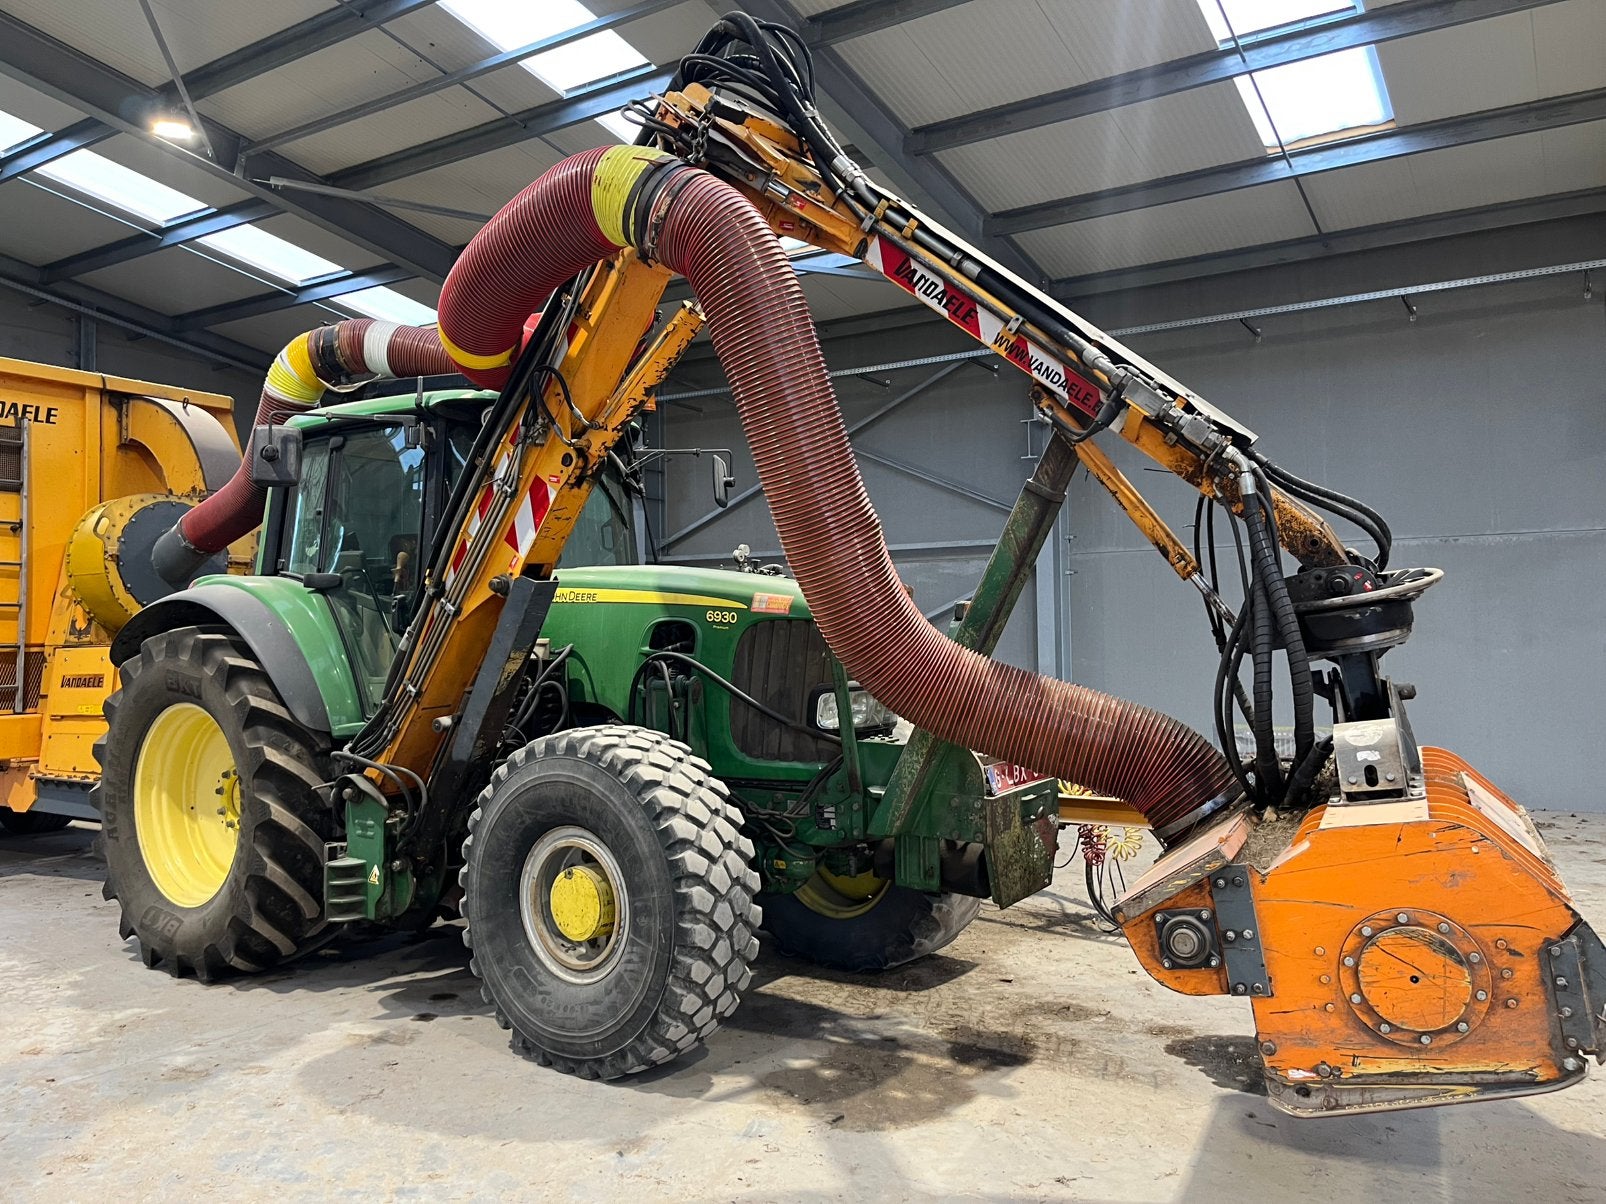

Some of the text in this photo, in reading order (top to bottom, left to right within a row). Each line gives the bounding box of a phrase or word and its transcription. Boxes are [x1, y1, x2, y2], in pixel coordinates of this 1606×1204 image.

[894, 257, 978, 325] VANDAELE
[569, 590, 598, 602] DEERE
[706, 611, 737, 624] 6930
[61, 675, 104, 688] VANDAELE
